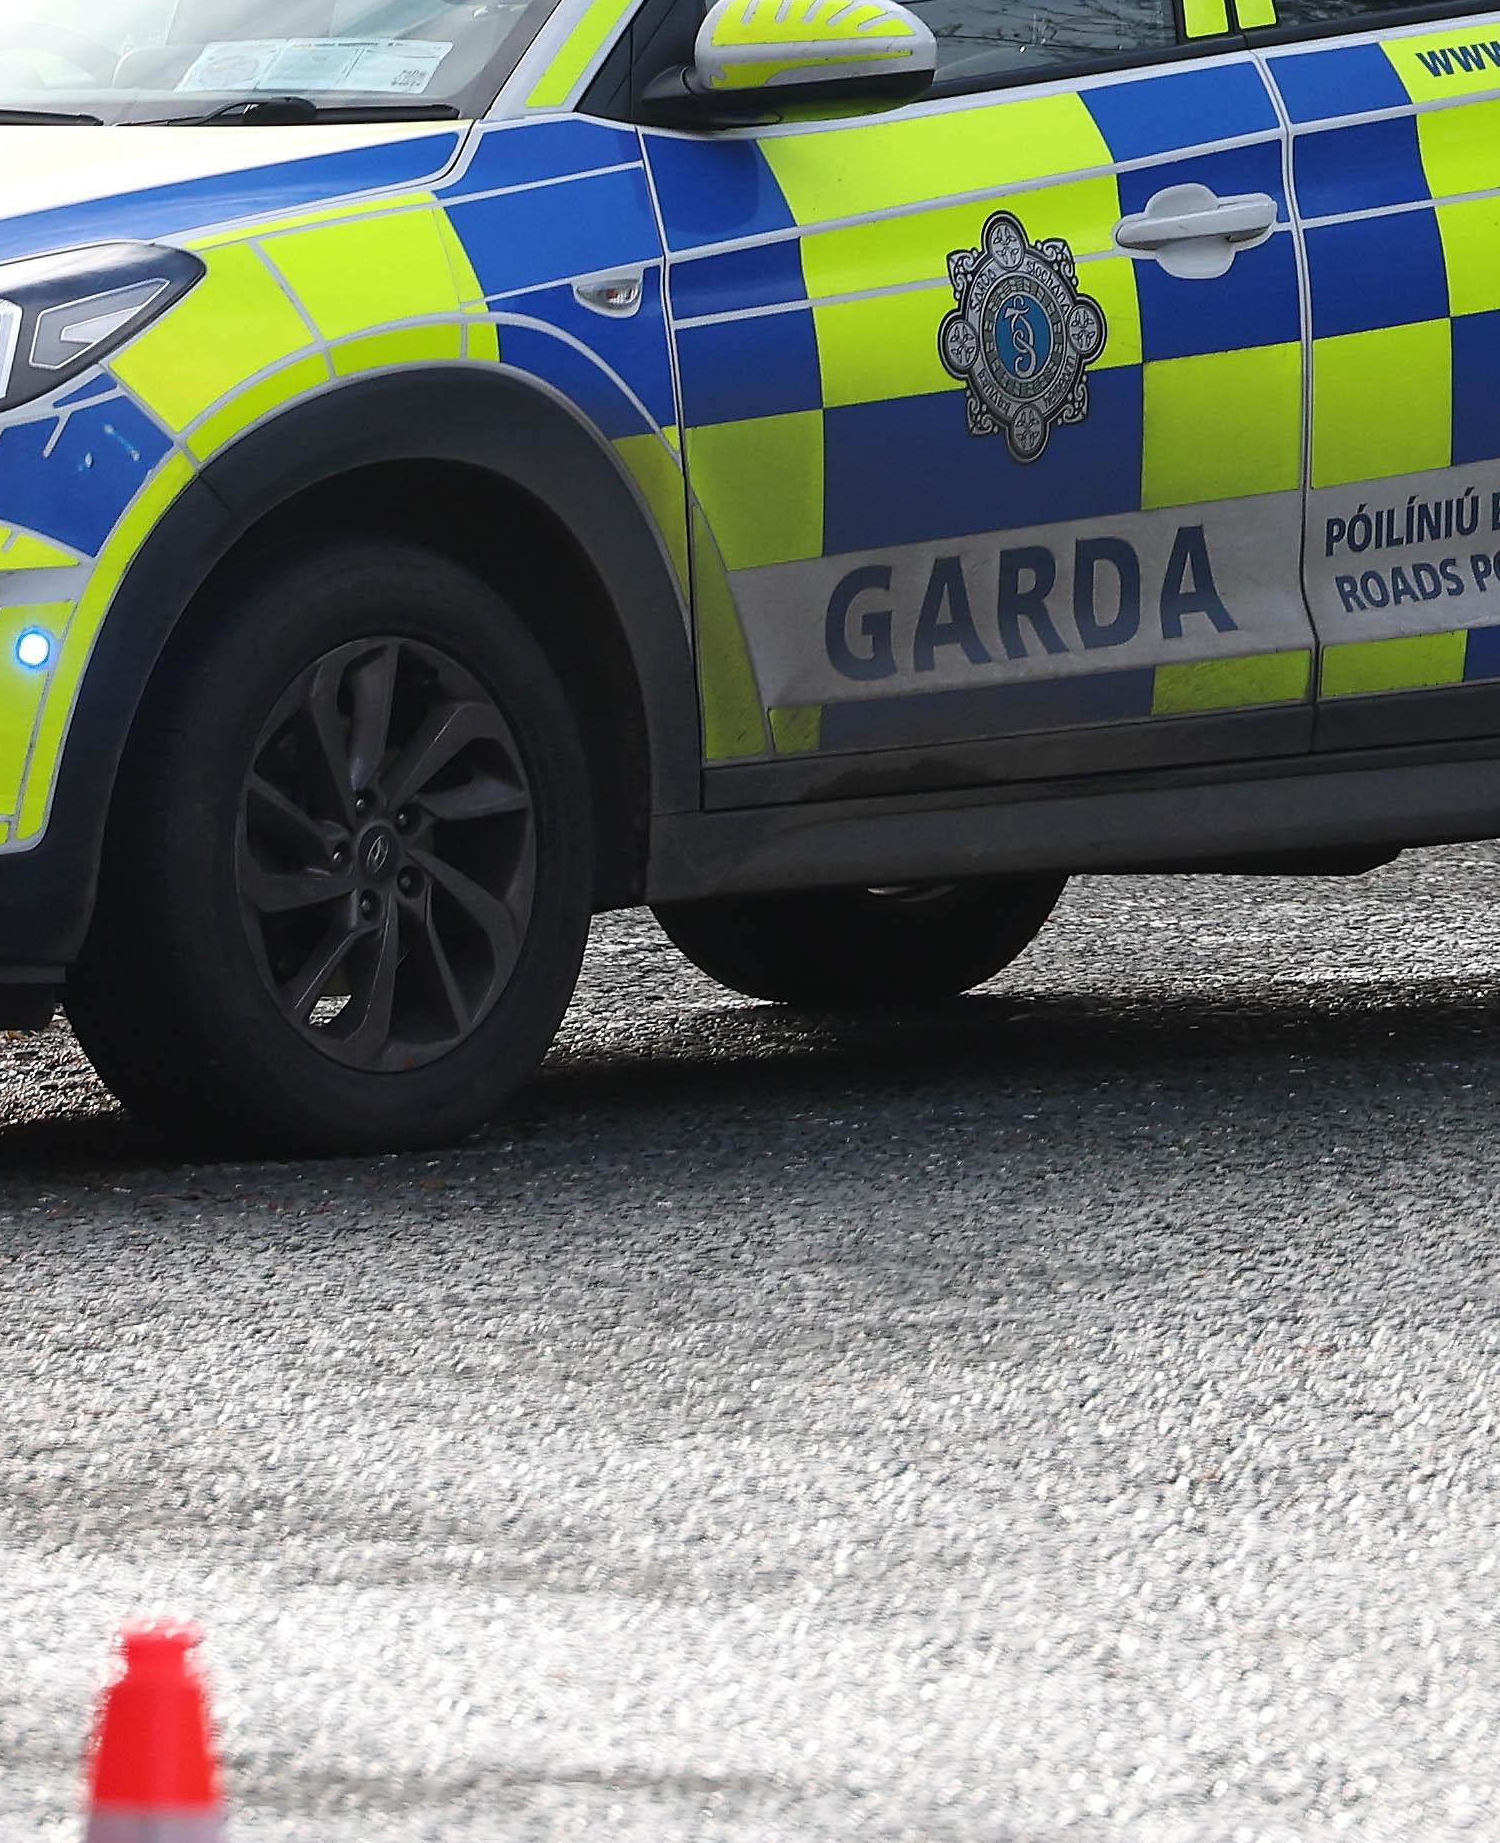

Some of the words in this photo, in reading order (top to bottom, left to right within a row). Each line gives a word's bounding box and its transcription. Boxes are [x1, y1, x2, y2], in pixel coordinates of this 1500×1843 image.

[1326, 483, 1478, 556] PÓILÍNIÚ
[824, 525, 1238, 681] GARDA
[1335, 561, 1466, 615] ROADS
